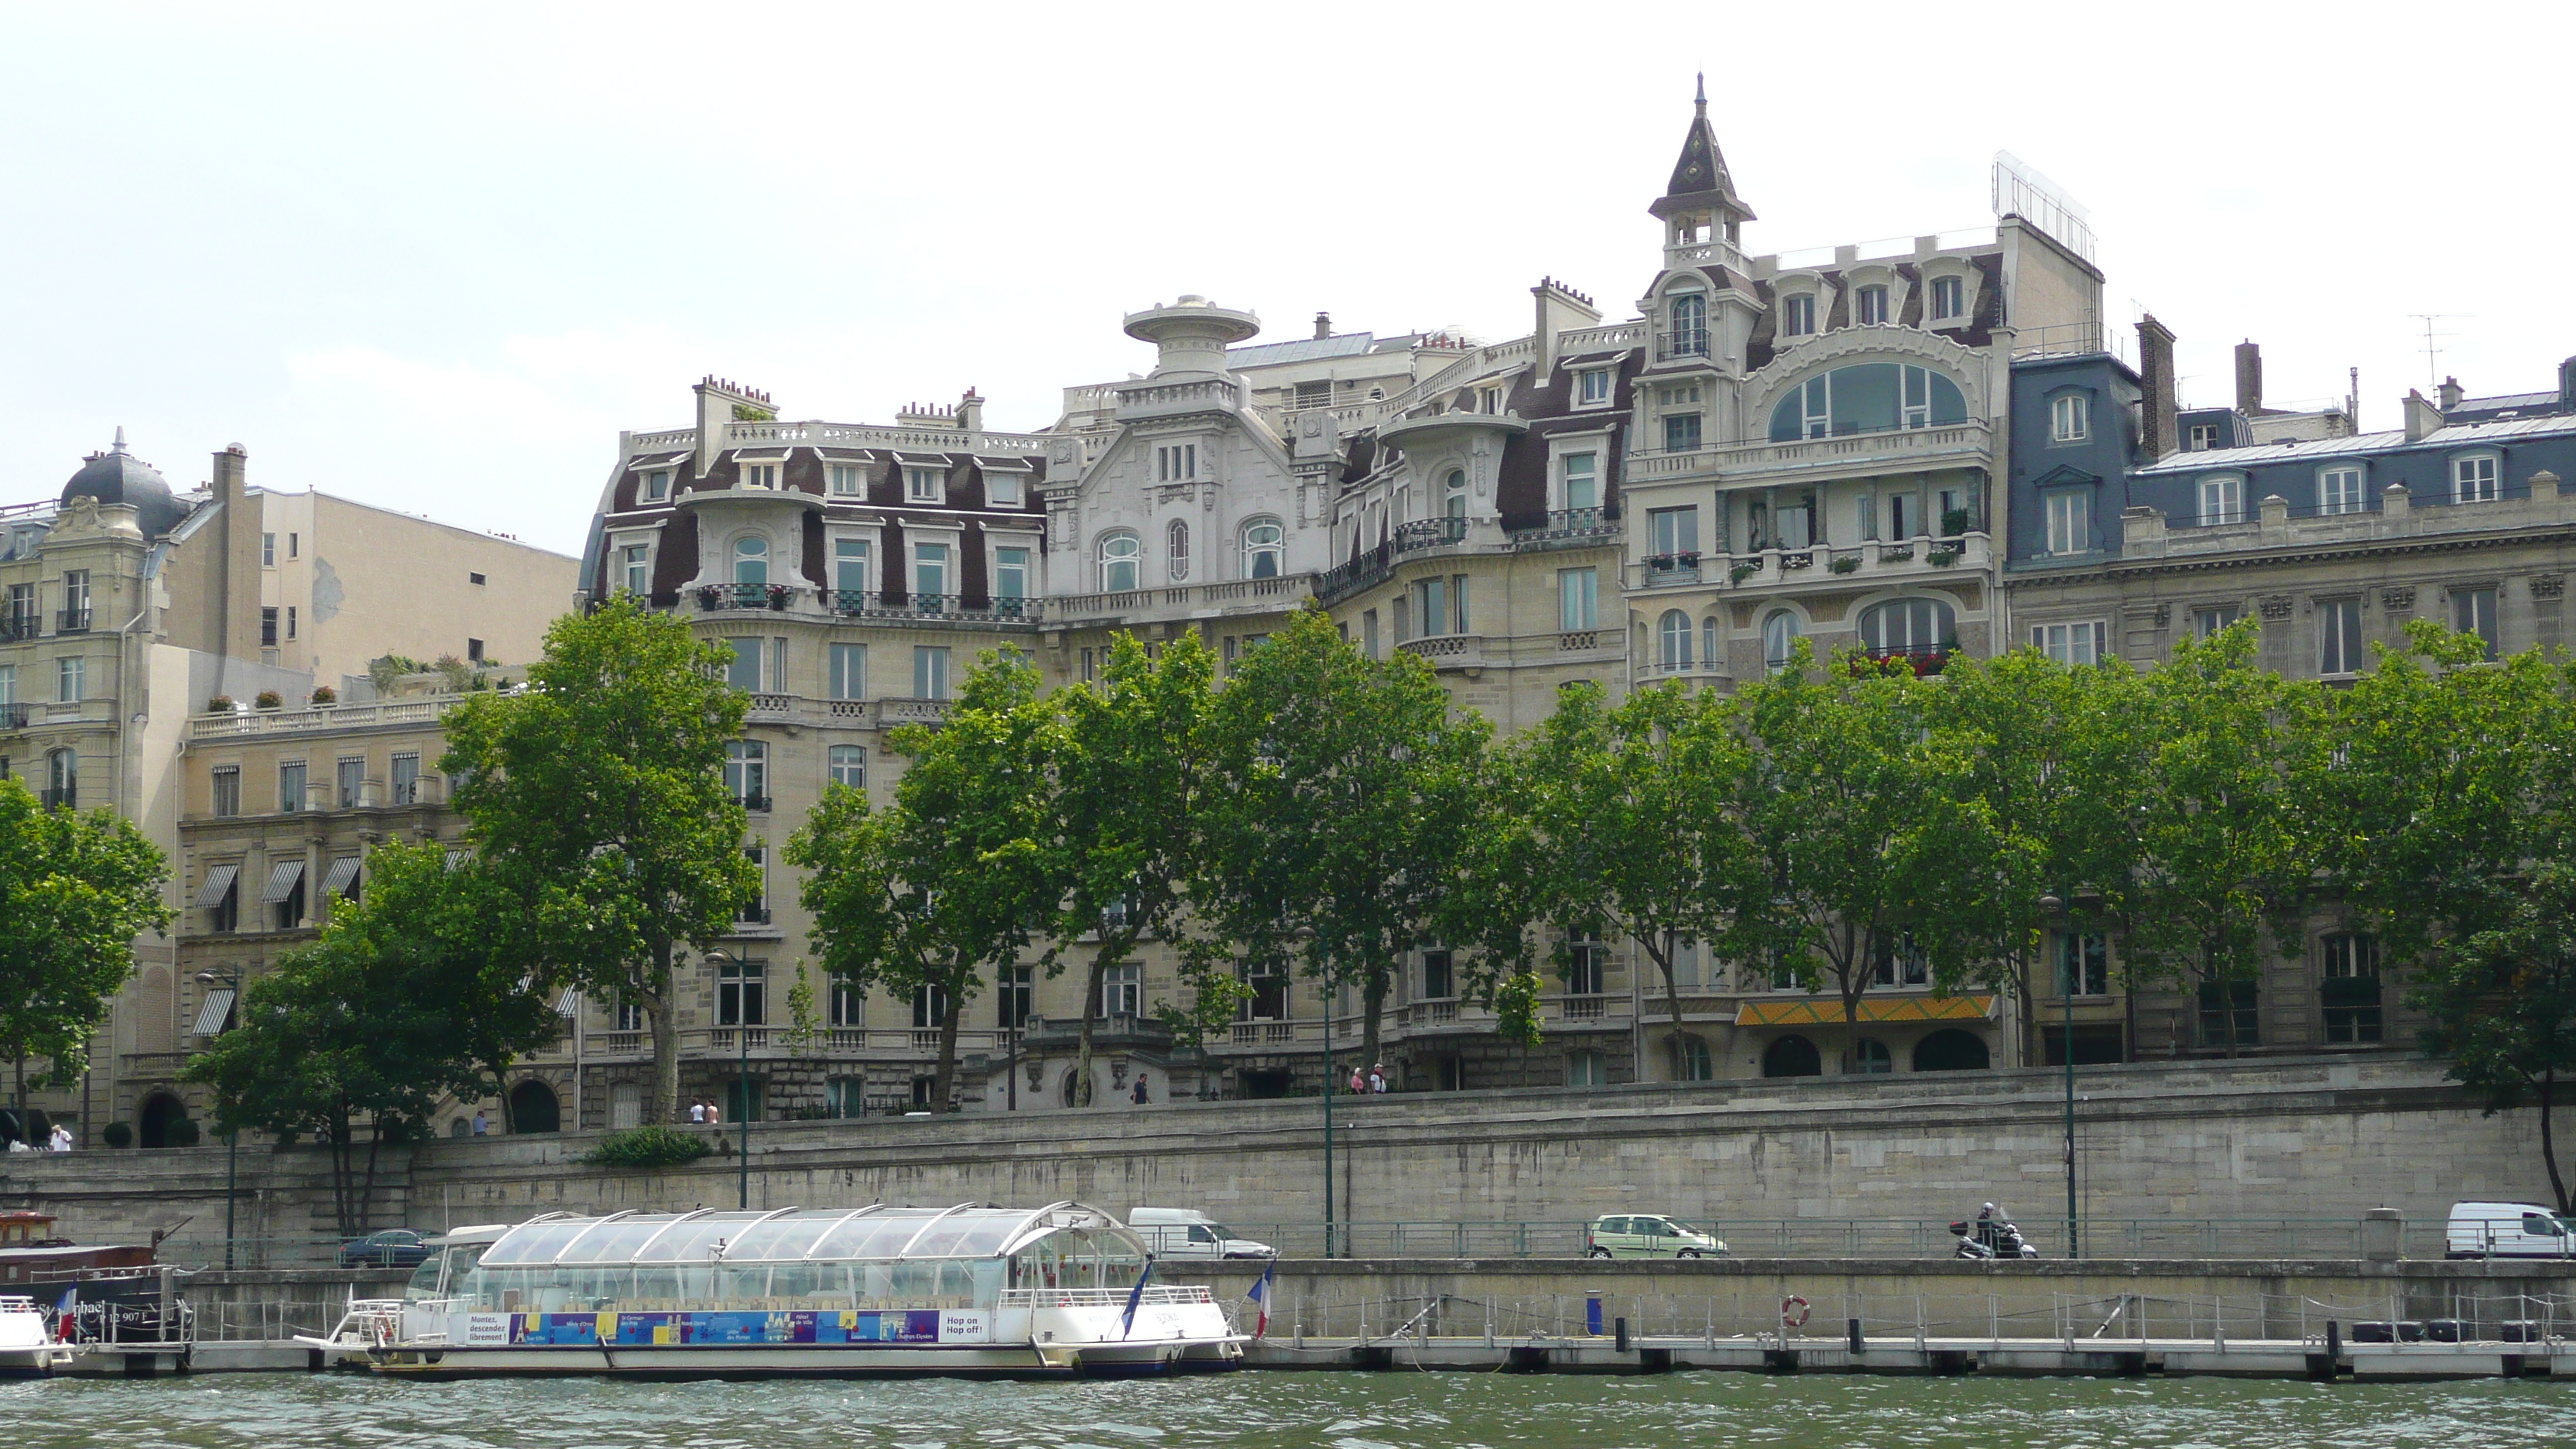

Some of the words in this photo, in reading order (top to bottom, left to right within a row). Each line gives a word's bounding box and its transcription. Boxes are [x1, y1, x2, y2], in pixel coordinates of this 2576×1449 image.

[122, 1312, 139, 1322] 907
[947, 1316, 964, 1326] Hop
[947, 1325, 964, 1335] Hop
